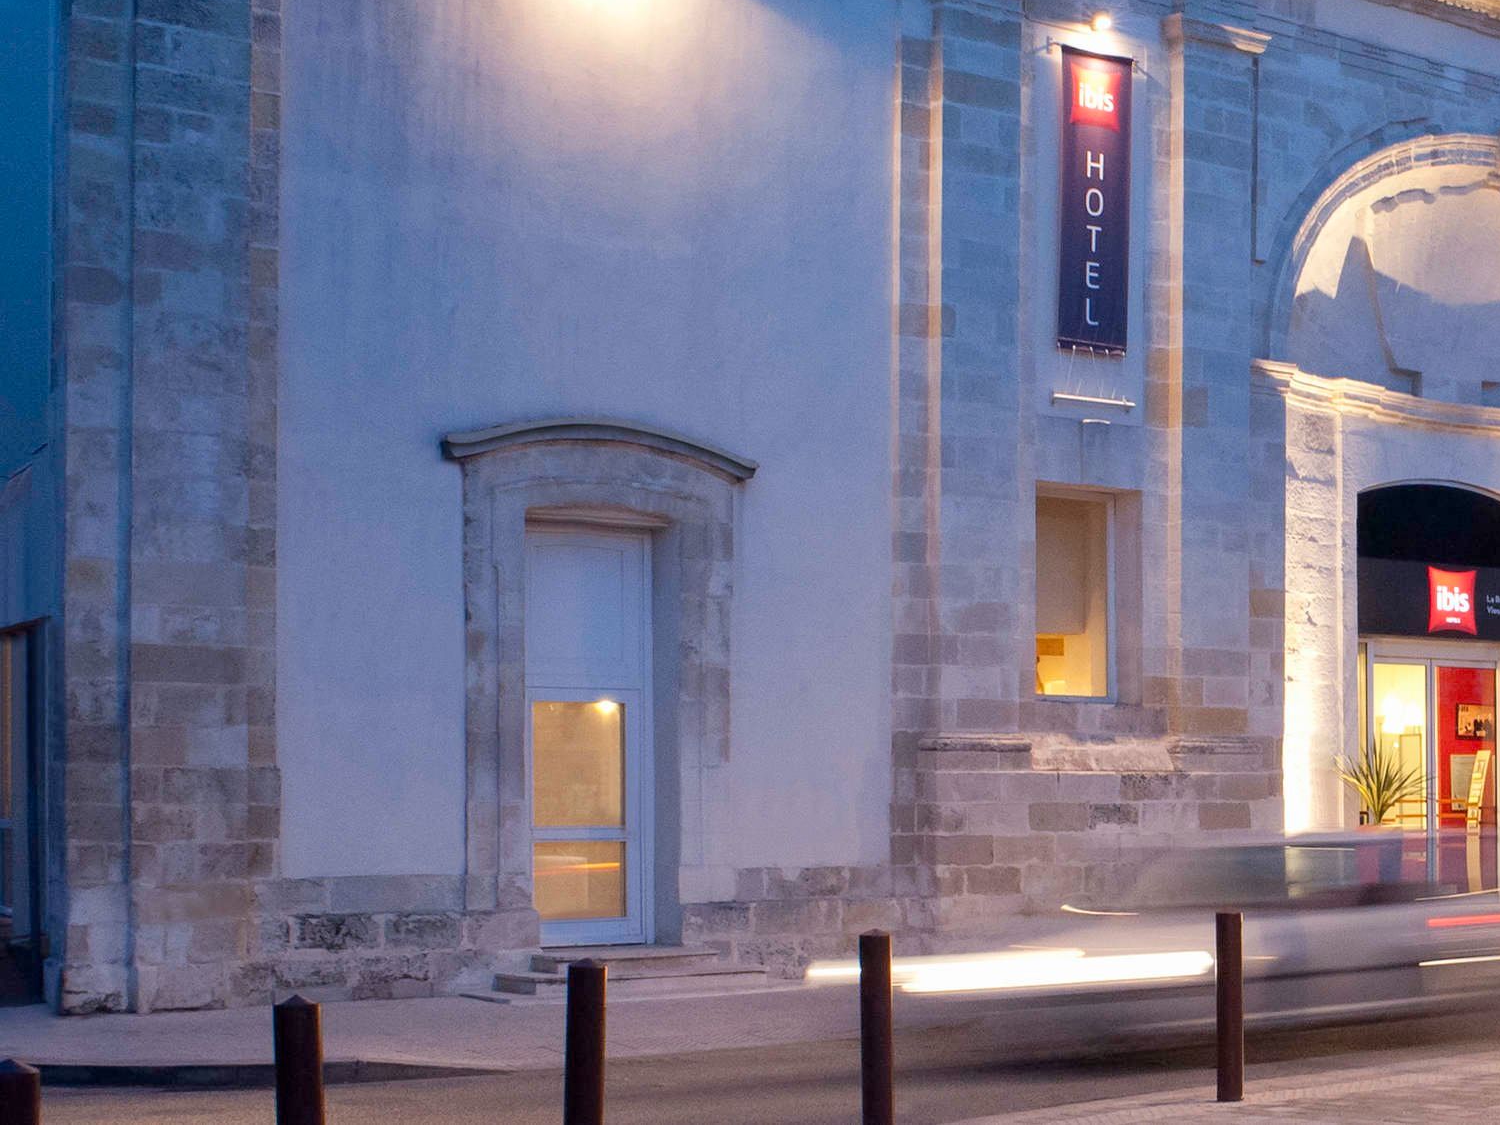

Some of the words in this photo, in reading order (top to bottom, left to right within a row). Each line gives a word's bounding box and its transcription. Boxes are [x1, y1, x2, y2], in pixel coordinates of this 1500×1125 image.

[1079, 82, 1114, 112] ibis
[1085, 150, 1105, 326] HOTEL
[1436, 585, 1470, 613] ibis
